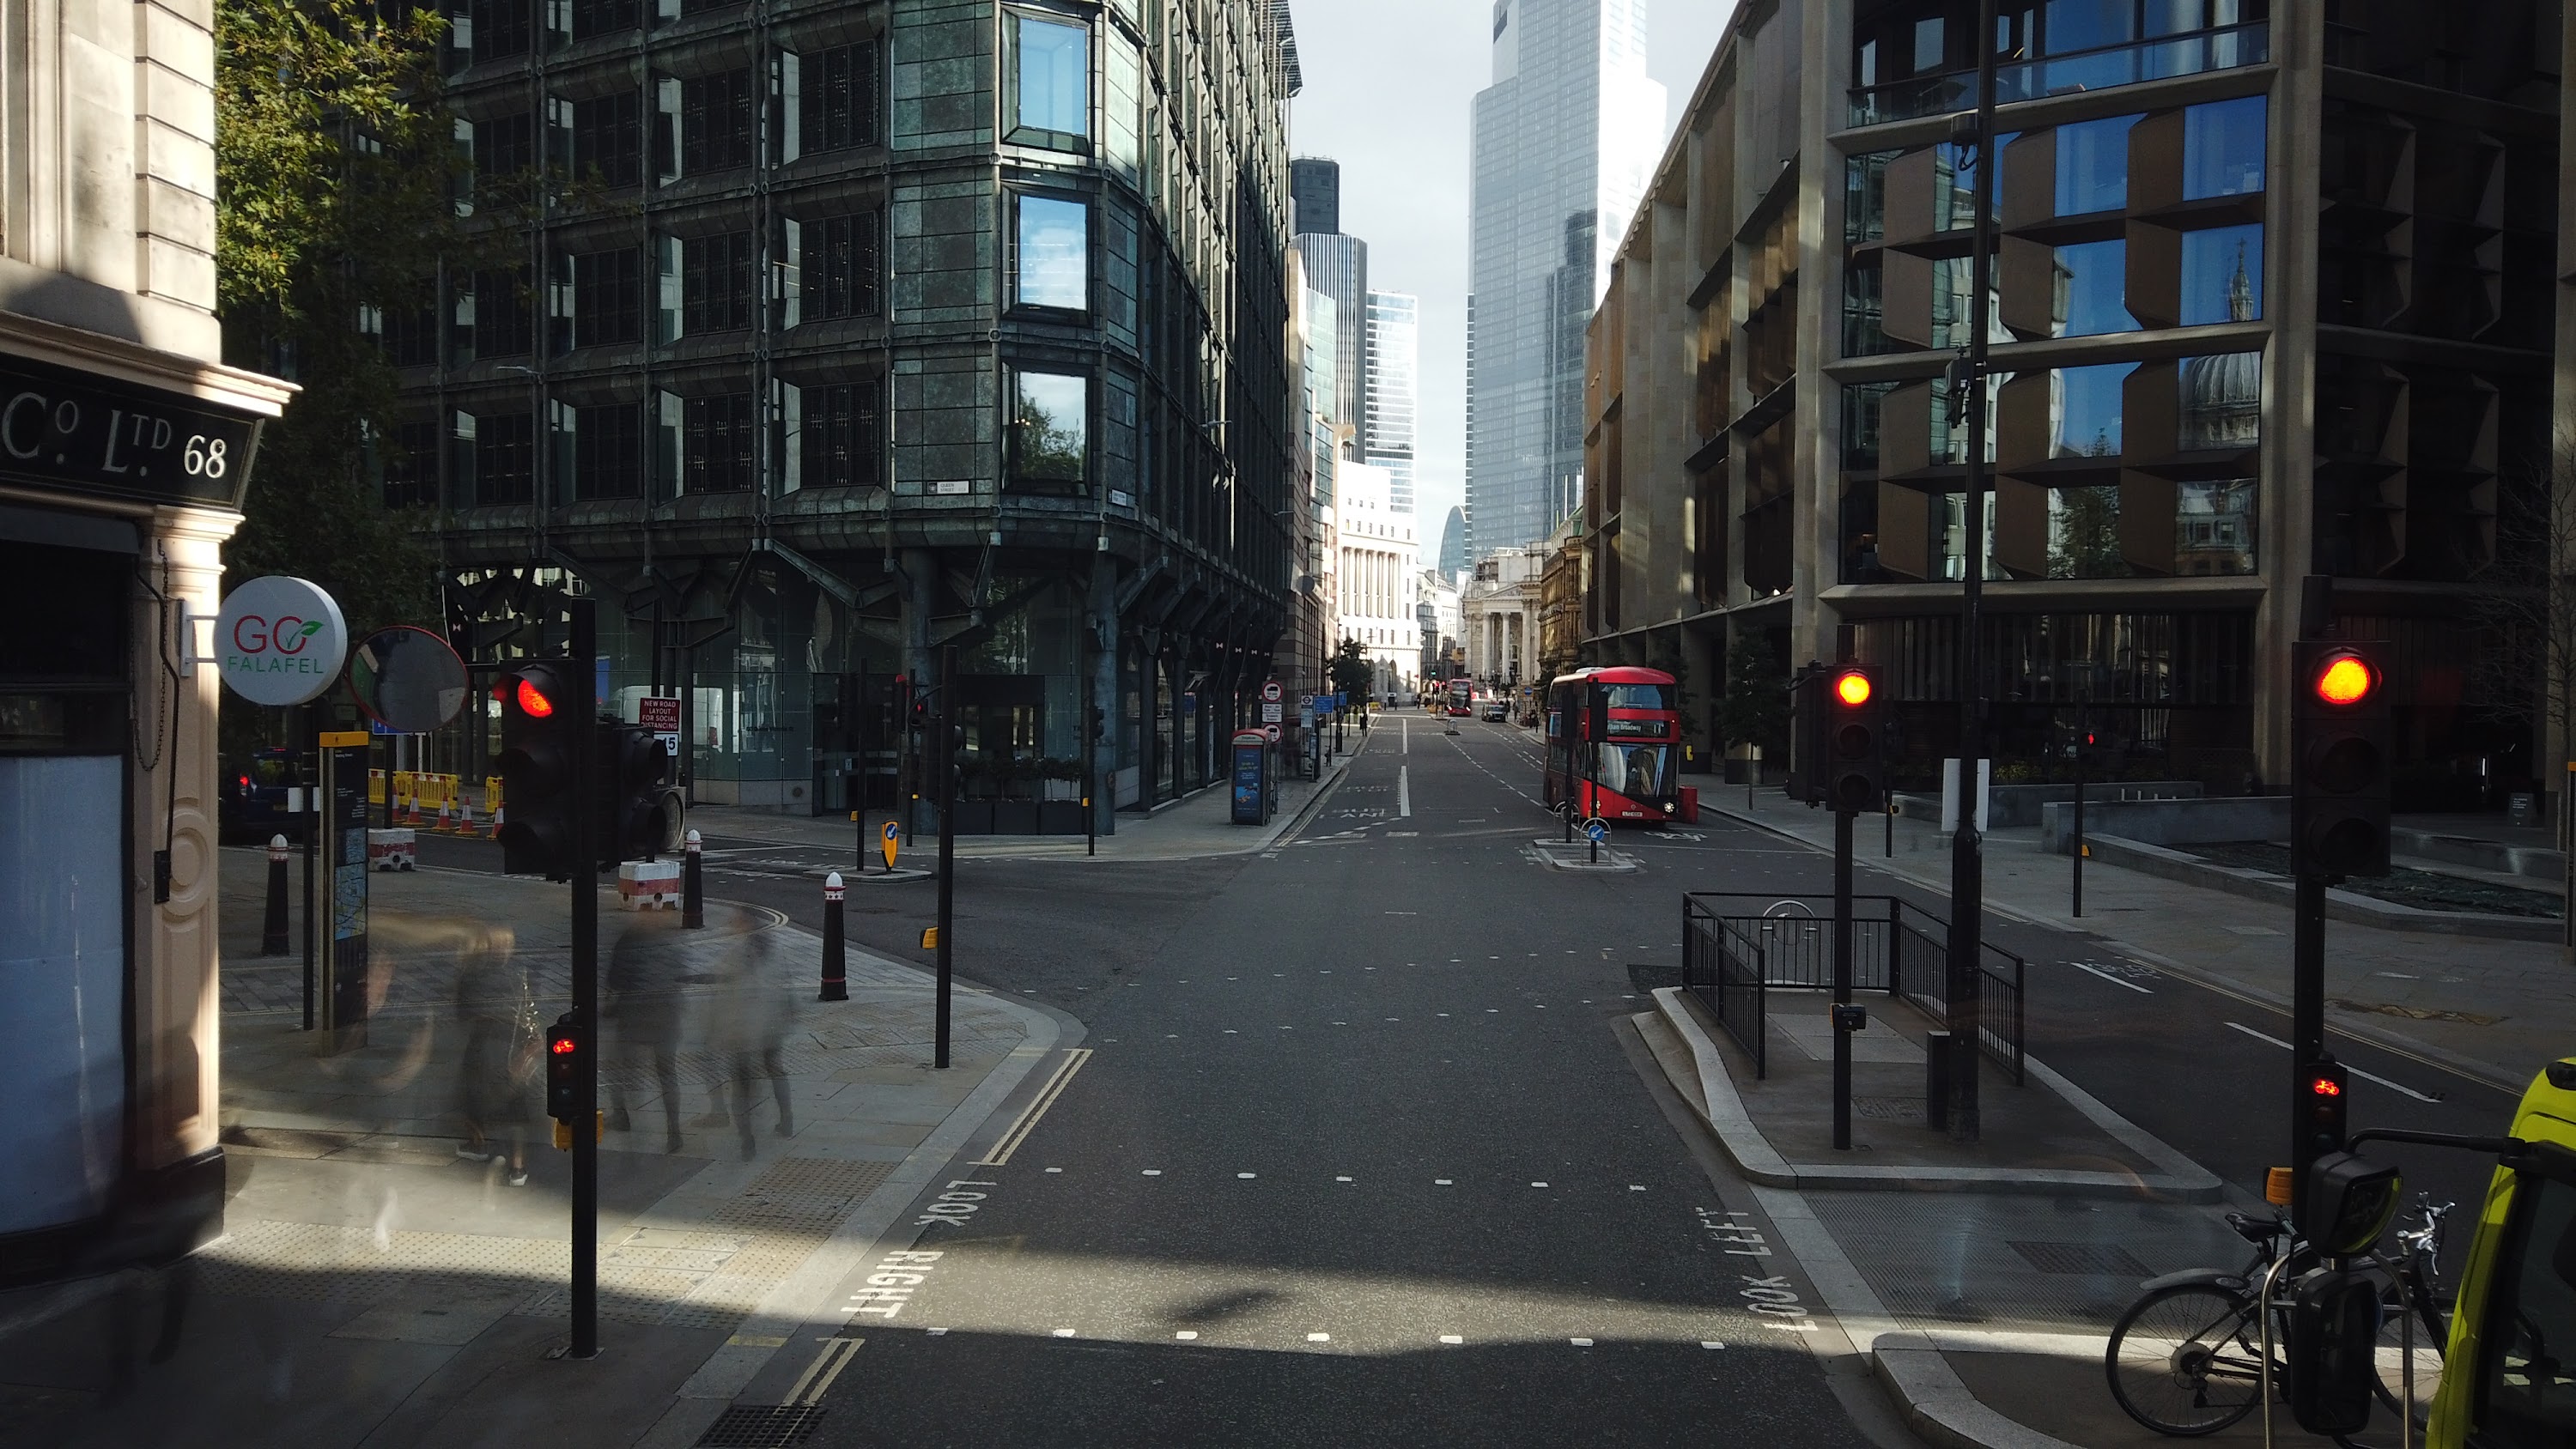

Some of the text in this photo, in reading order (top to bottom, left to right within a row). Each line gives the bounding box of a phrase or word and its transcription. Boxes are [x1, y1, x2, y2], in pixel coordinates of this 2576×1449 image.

[183, 434, 228, 478] 68
[234, 615, 309, 655] GO
[228, 657, 324, 674] FALAFEL
[840, 1180, 997, 1319] LOOK RIGHT
[1695, 1206, 1819, 1331] LOOK LEFT
